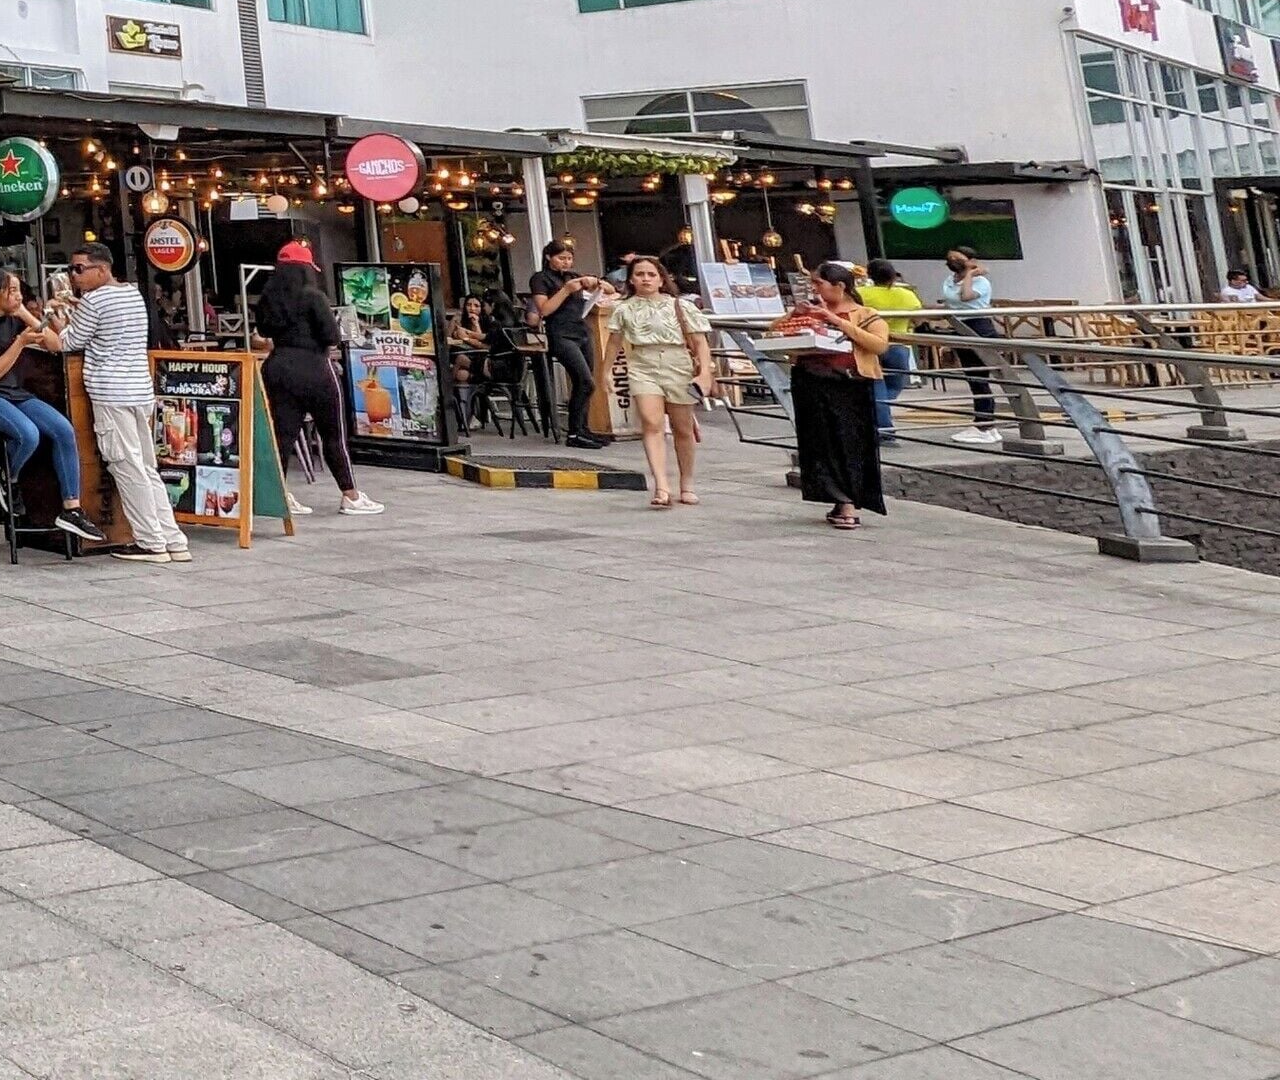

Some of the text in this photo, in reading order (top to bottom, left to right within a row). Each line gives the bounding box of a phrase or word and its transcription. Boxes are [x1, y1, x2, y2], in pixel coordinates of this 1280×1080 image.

[358, 159, 406, 175] GANCHOS
[149, 236, 180, 245] AMSTEL
[154, 247, 176, 255] LAGER
[375, 336, 410, 346] HOUR
[168, 362, 228, 374] HAPPY HOUR
